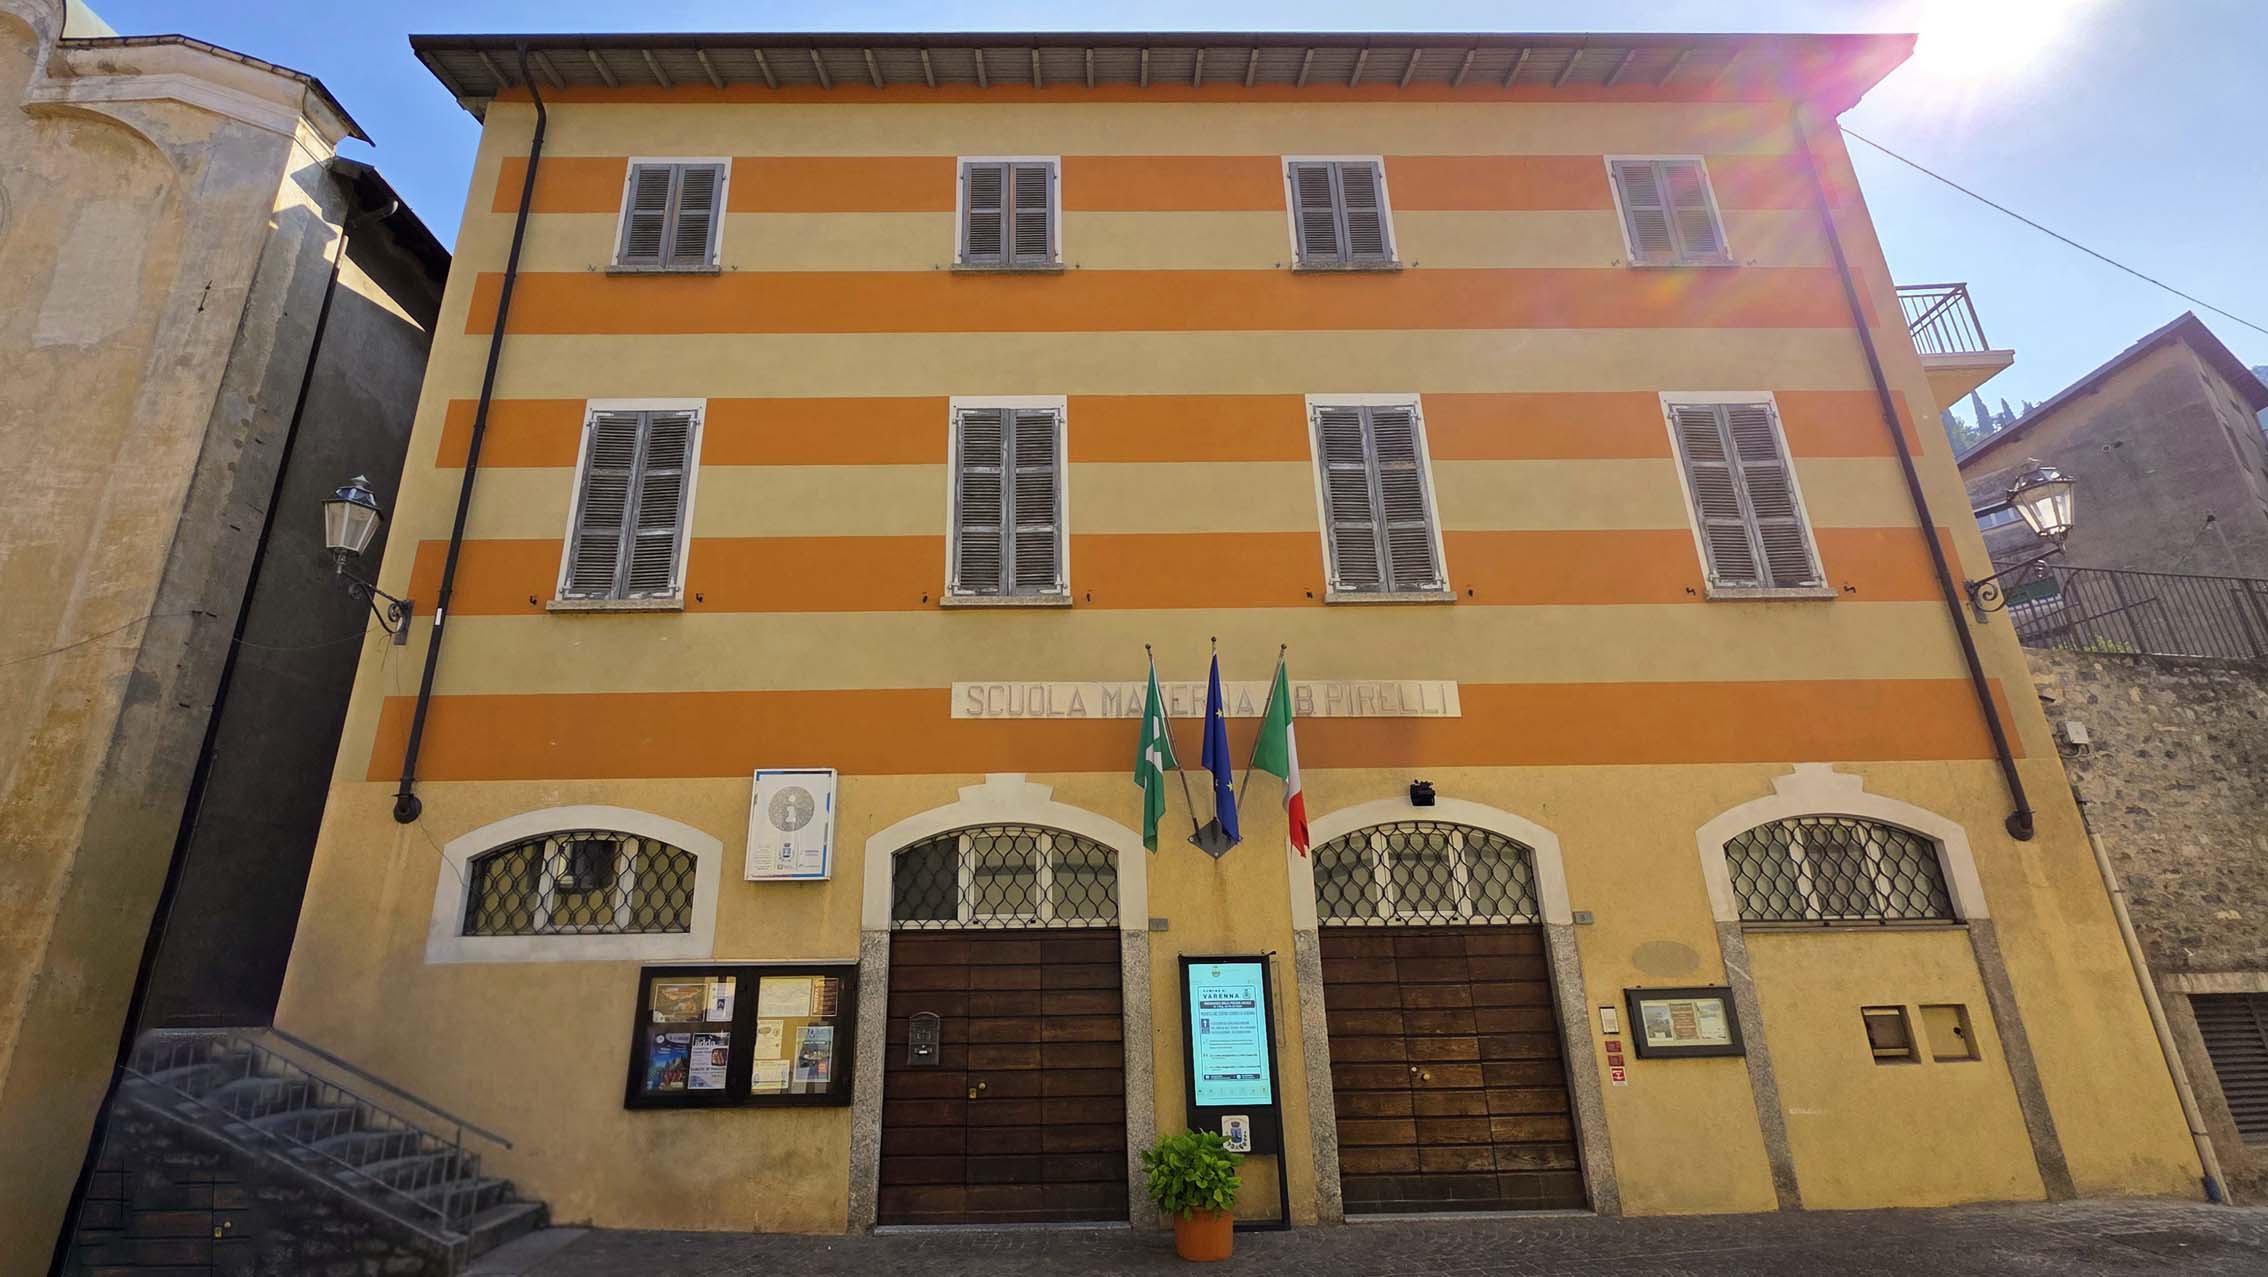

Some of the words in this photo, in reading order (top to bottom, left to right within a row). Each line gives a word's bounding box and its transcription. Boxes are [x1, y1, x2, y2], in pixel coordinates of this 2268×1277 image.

[966, 684, 1087, 717] SCUOLA
[1102, 684, 1255, 717] MAERA
[1325, 683, 1448, 716] PIRELLI
